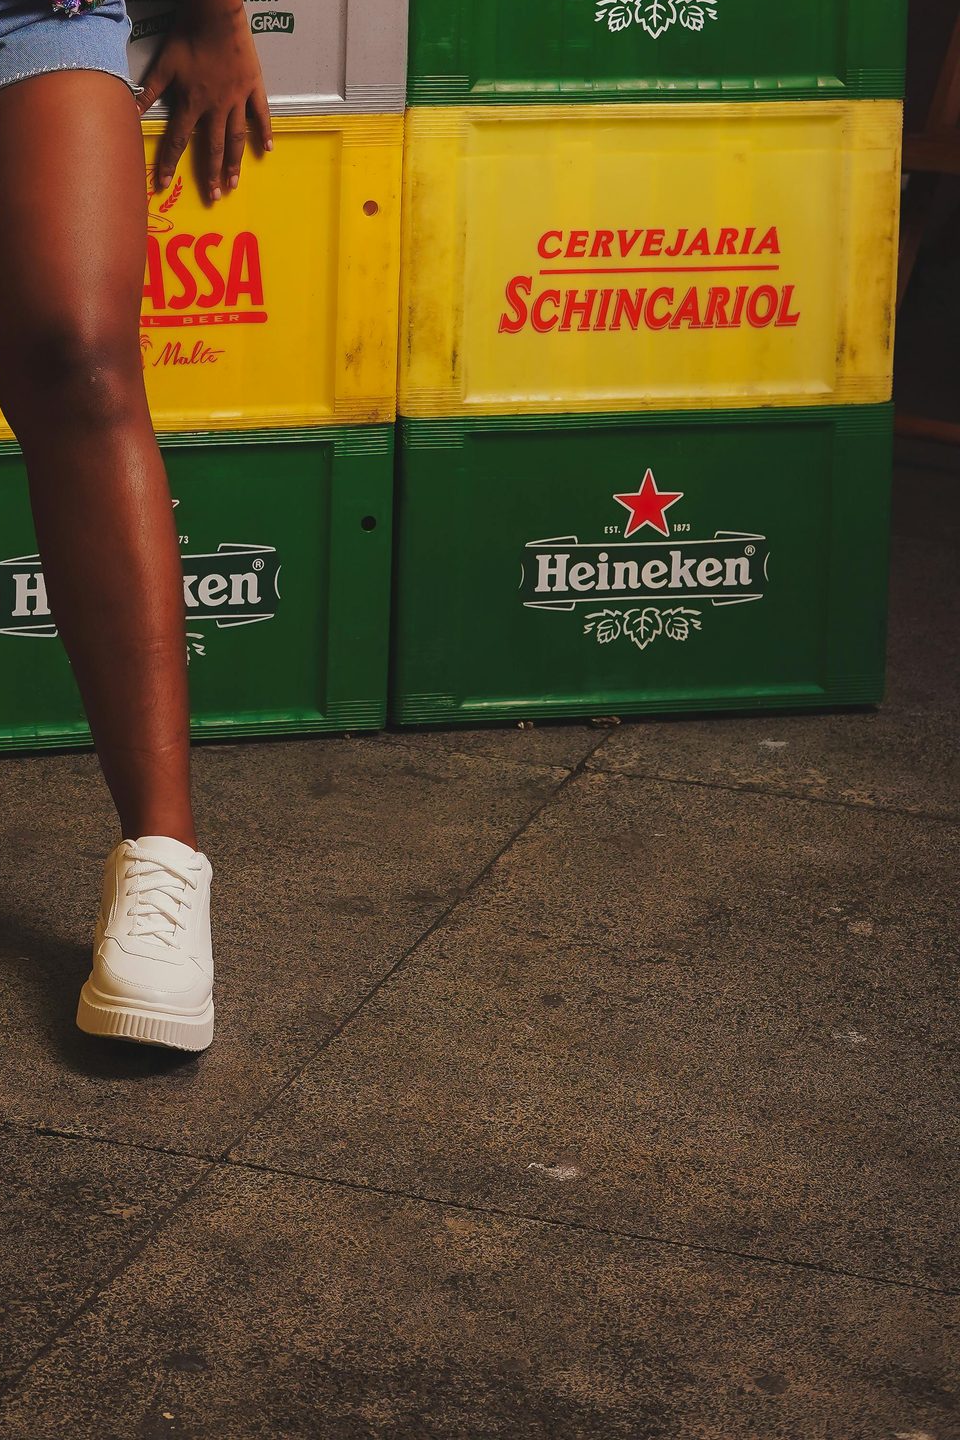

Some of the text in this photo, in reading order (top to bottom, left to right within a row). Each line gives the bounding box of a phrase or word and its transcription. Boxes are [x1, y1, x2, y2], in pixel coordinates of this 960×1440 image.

[252, 16, 290, 31] GRAU
[537, 226, 781, 259] CERVEJARIA
[498, 275, 801, 334] SCHINCARIOL
[183, 314, 241, 325] BEER
[152, 340, 226, 367] Malte
[604, 523, 691, 534] EST. 1873
